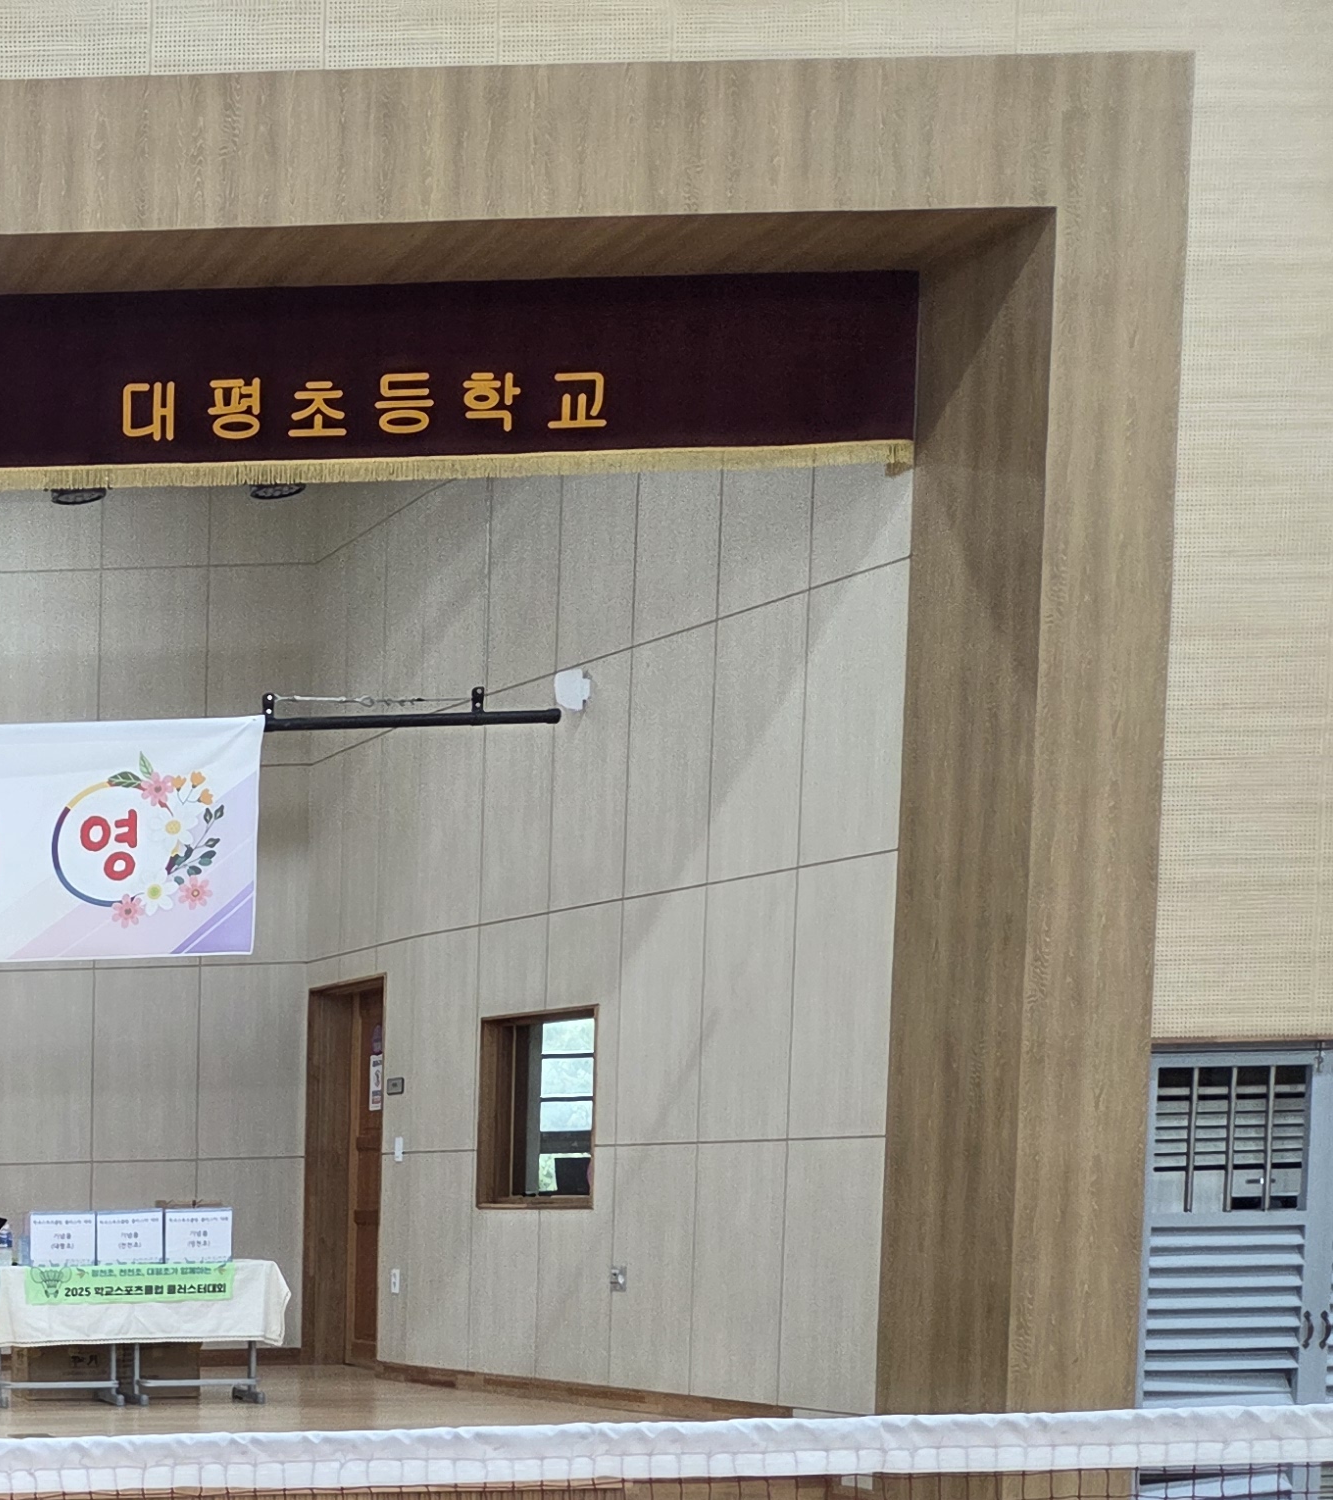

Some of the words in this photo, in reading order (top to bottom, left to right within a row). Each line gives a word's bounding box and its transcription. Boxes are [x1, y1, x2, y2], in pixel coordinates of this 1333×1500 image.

[122, 372, 607, 442] 대평초등학교
[80, 809, 136, 881] 영
[64, 1287, 91, 1297] 2025
